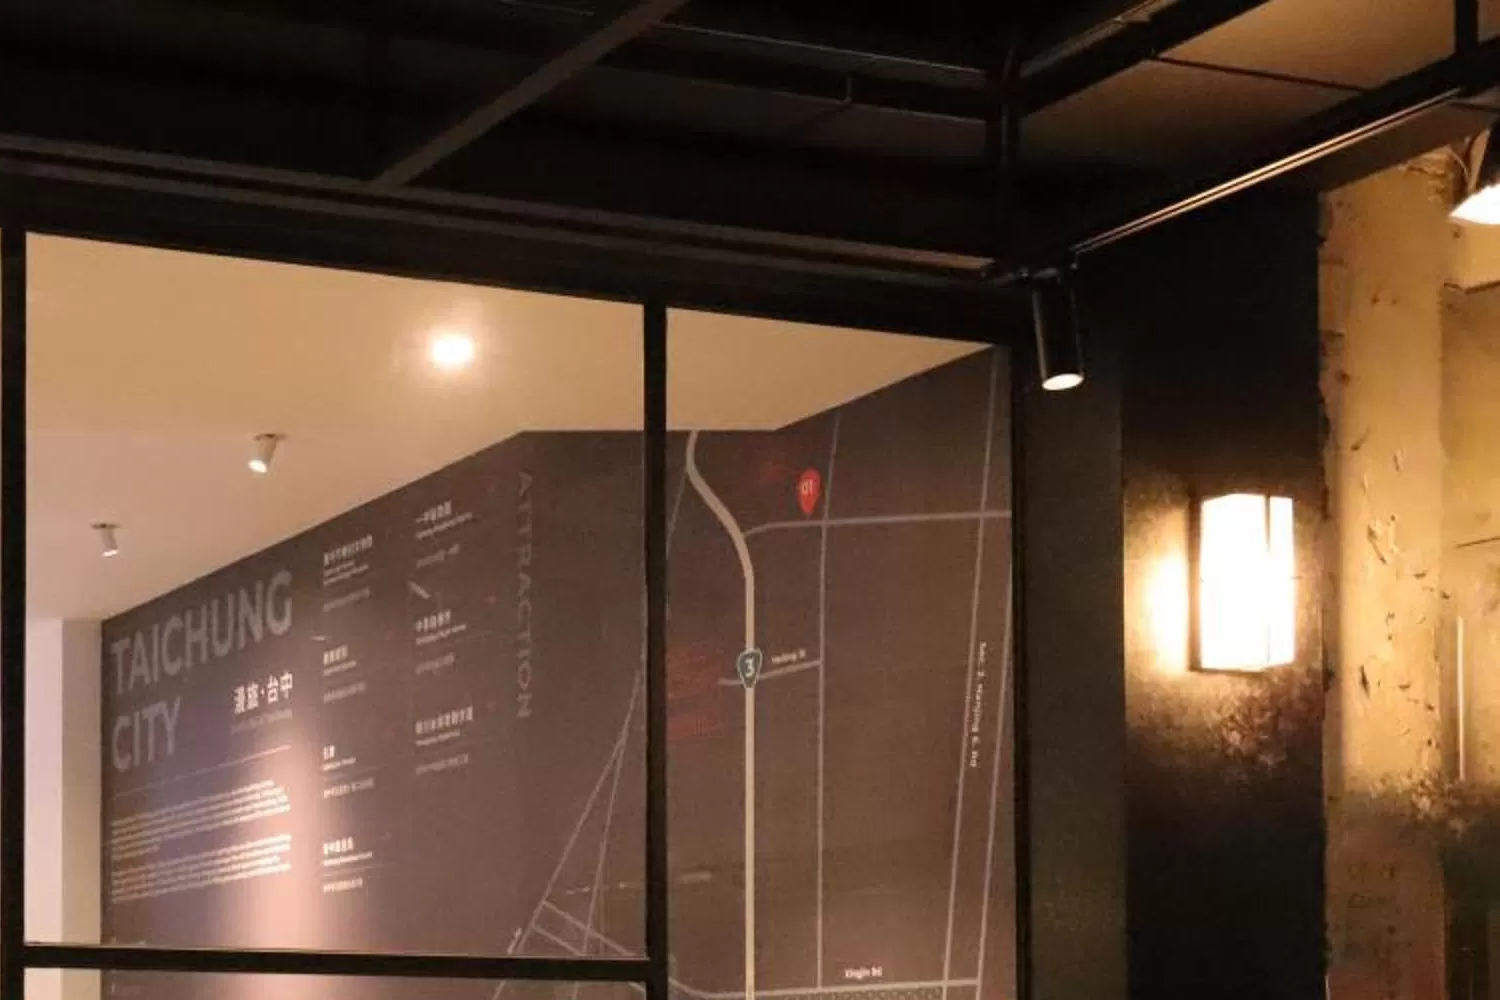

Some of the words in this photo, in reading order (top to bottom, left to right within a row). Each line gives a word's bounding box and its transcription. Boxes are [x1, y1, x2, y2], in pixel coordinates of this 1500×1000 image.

[110, 569, 293, 696] TAICHUNG
[515, 471, 533, 719] ATTRACTION
[743, 657, 755, 678] 3
[111, 695, 182, 772] CITY
